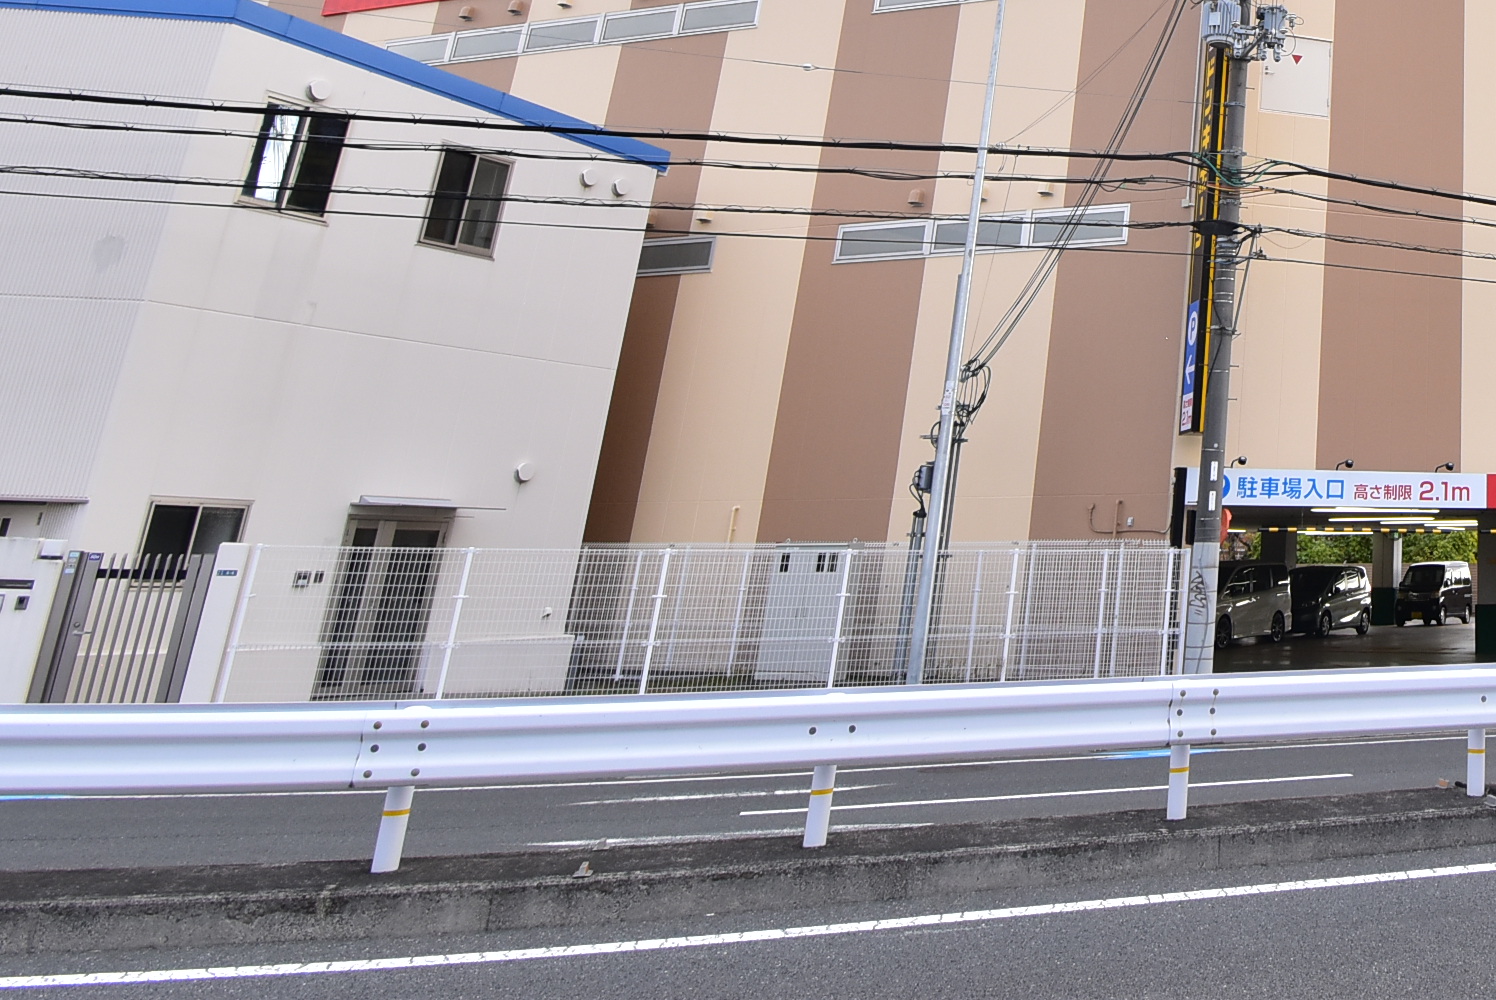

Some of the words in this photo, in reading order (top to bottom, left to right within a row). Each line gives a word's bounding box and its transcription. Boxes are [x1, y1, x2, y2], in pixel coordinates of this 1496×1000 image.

[1236, 476, 1345, 500] 駐車場入口
[1353, 483, 1412, 501] 高さ制限
[1418, 481, 1471, 503] 2.1m
